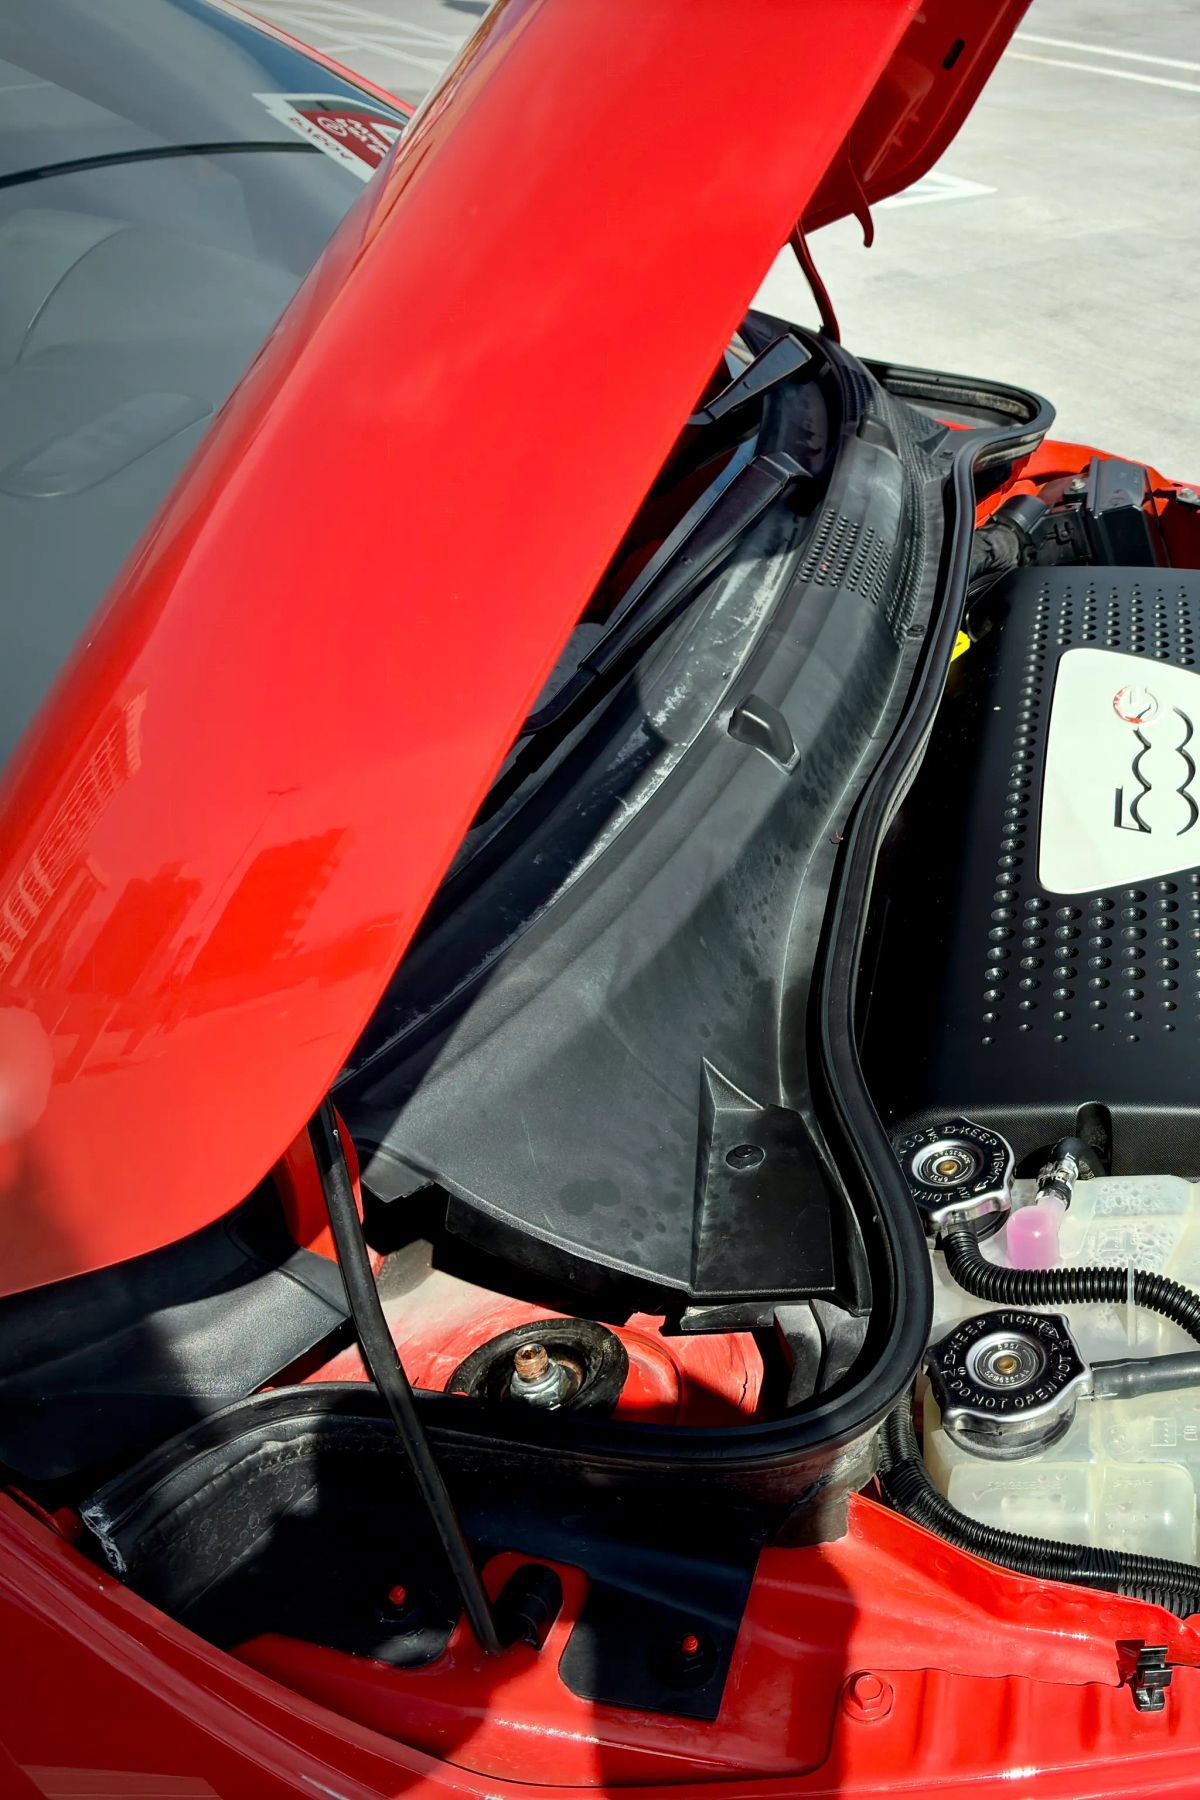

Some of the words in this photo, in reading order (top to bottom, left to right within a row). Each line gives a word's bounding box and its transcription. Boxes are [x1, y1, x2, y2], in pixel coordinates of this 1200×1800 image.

[961, 1127, 997, 1146] KEEP
[986, 1150, 1004, 1184] TIGHT
[950, 1319, 986, 1350] KEEP
[1000, 1313, 1049, 1332] TIGHT
[950, 1381, 971, 1397] DO
[971, 1393, 1008, 1409] NOT
[1014, 1382, 1058, 1408] OPEN
[1053, 1354, 1072, 1382] HOT
